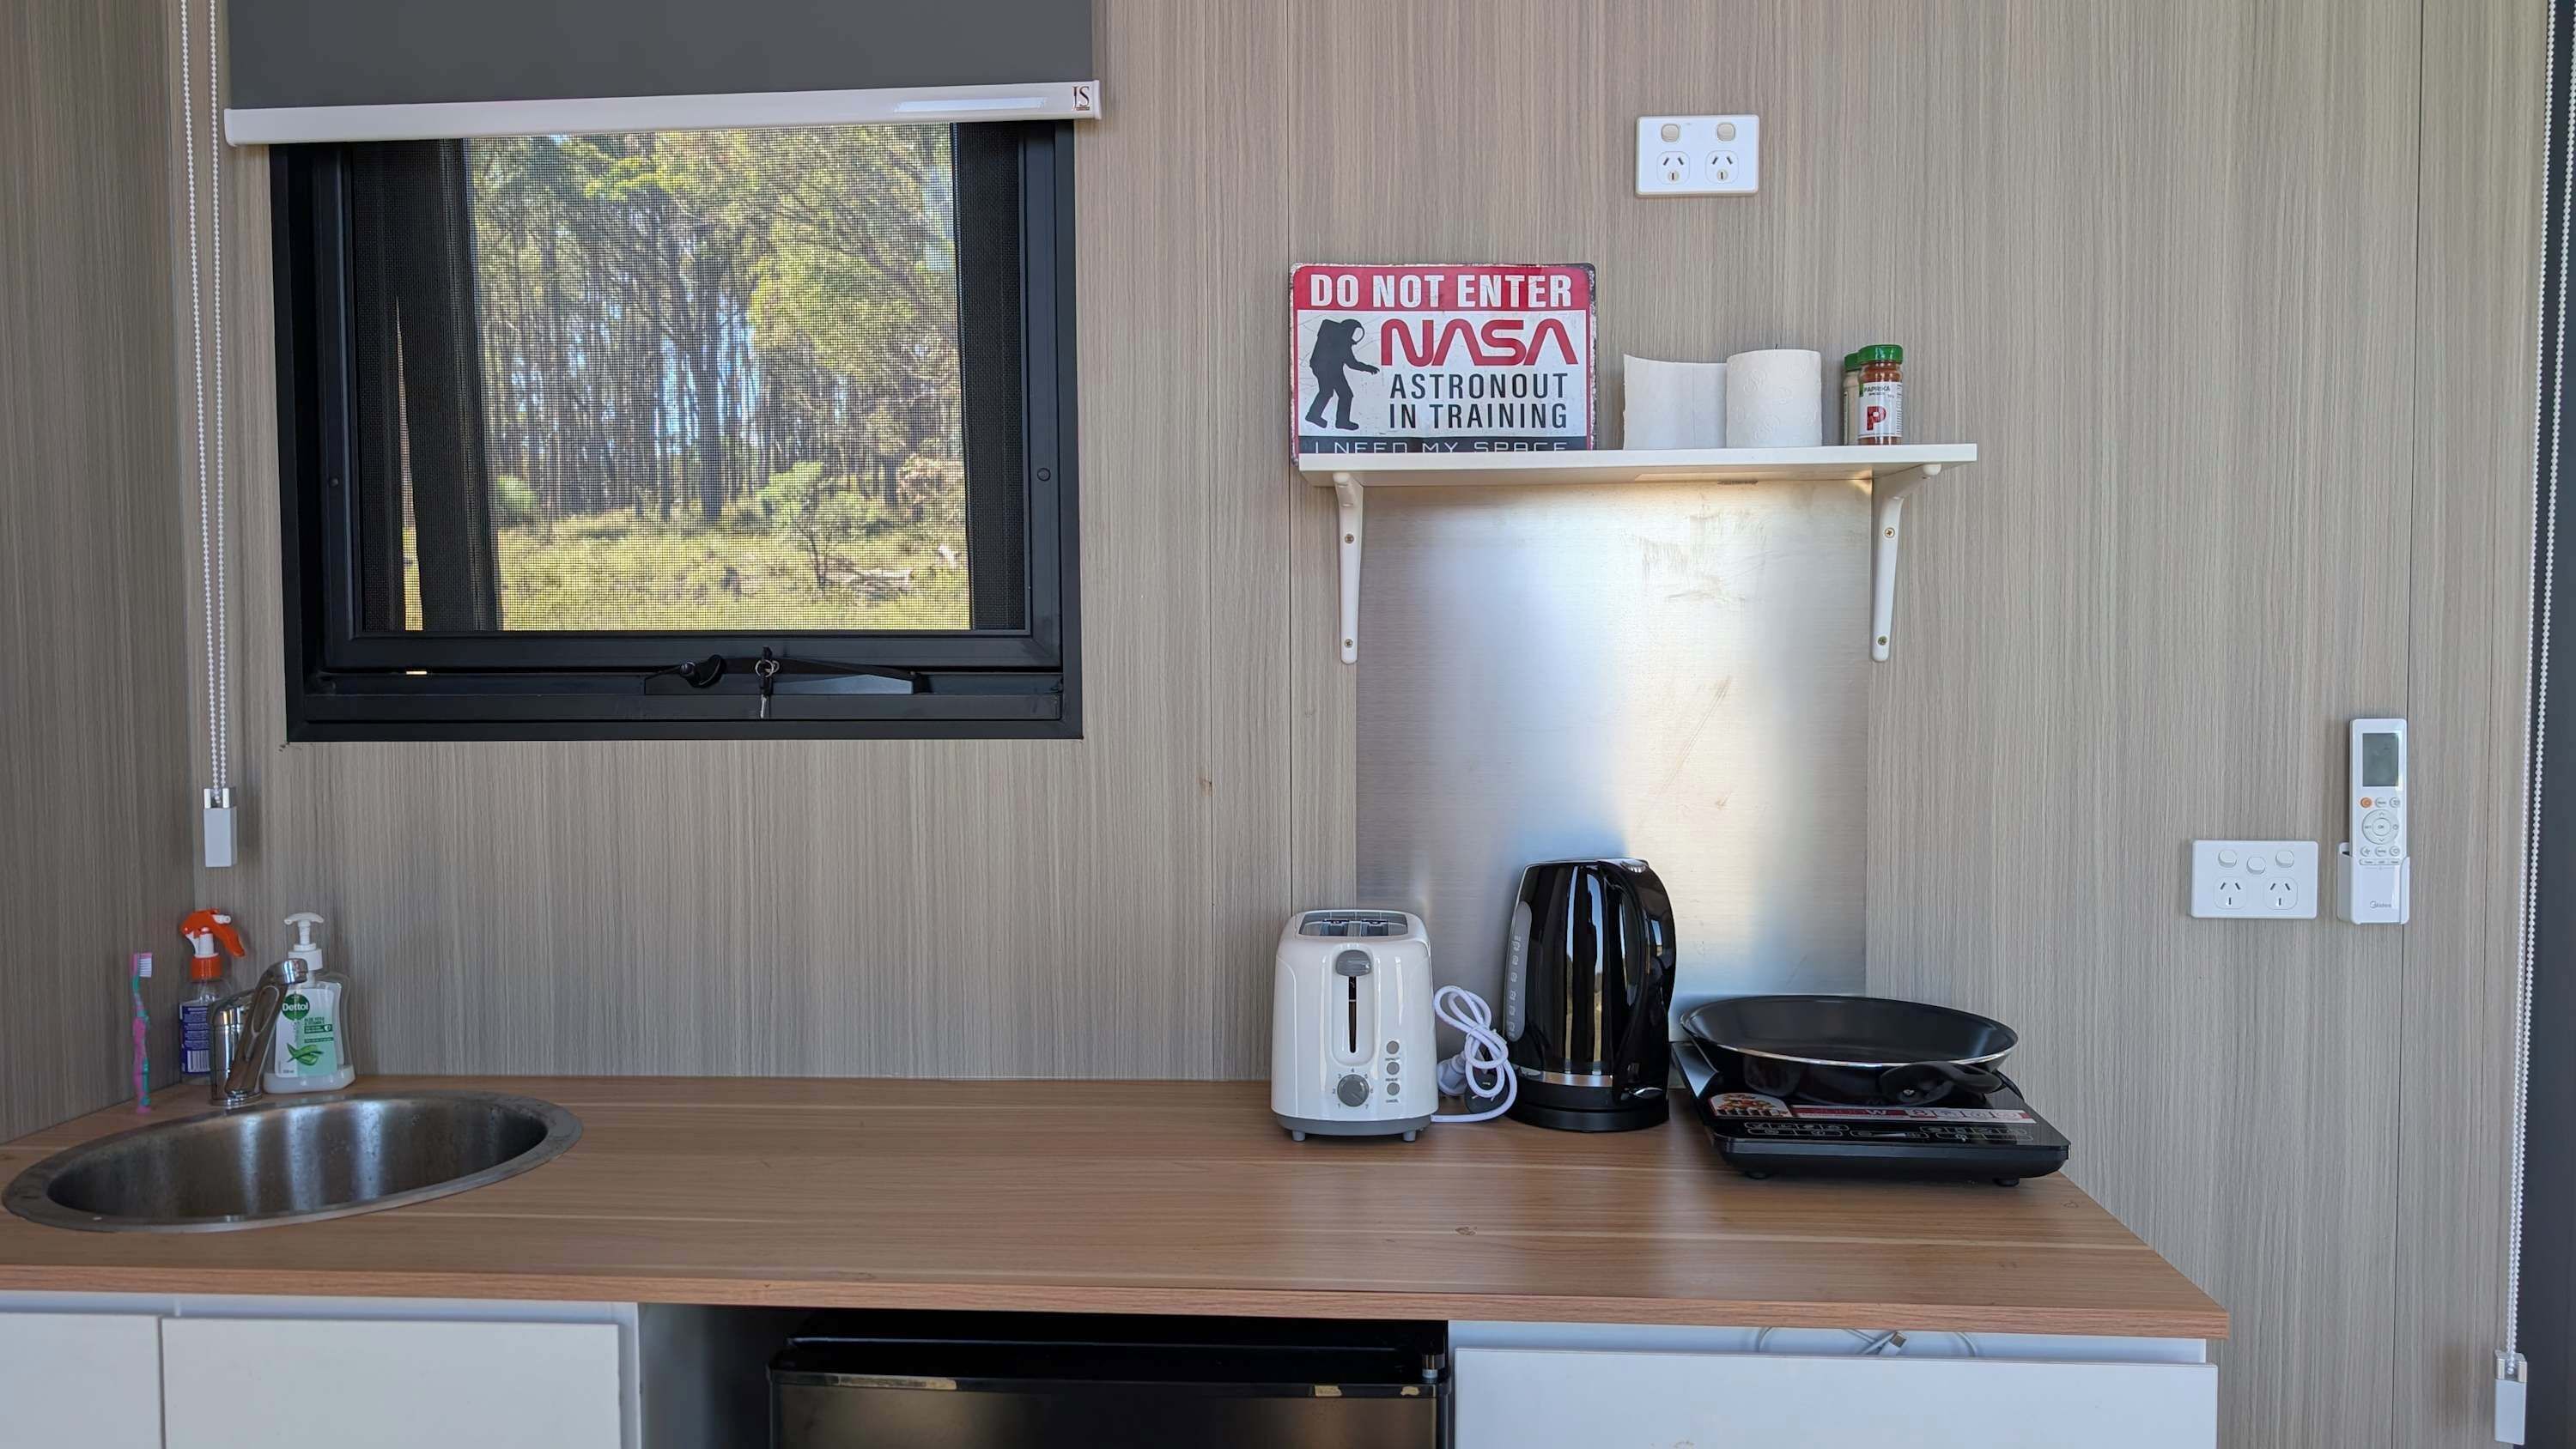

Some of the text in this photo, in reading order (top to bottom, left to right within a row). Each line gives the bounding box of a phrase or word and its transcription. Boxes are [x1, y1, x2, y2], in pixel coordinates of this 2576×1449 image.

[1310, 274, 1571, 307] DO NOT ENTER
[1381, 318, 1578, 367] NASA
[1389, 373, 1568, 399] ASTRONOUT
[1389, 403, 1568, 428] IN TRAINING
[1867, 406, 1886, 431] P
[1334, 442, 1407, 453] NEED
[1422, 441, 1458, 453] MY
[1473, 441, 1568, 452] SPACE
[282, 1003, 309, 1011] Dettol
